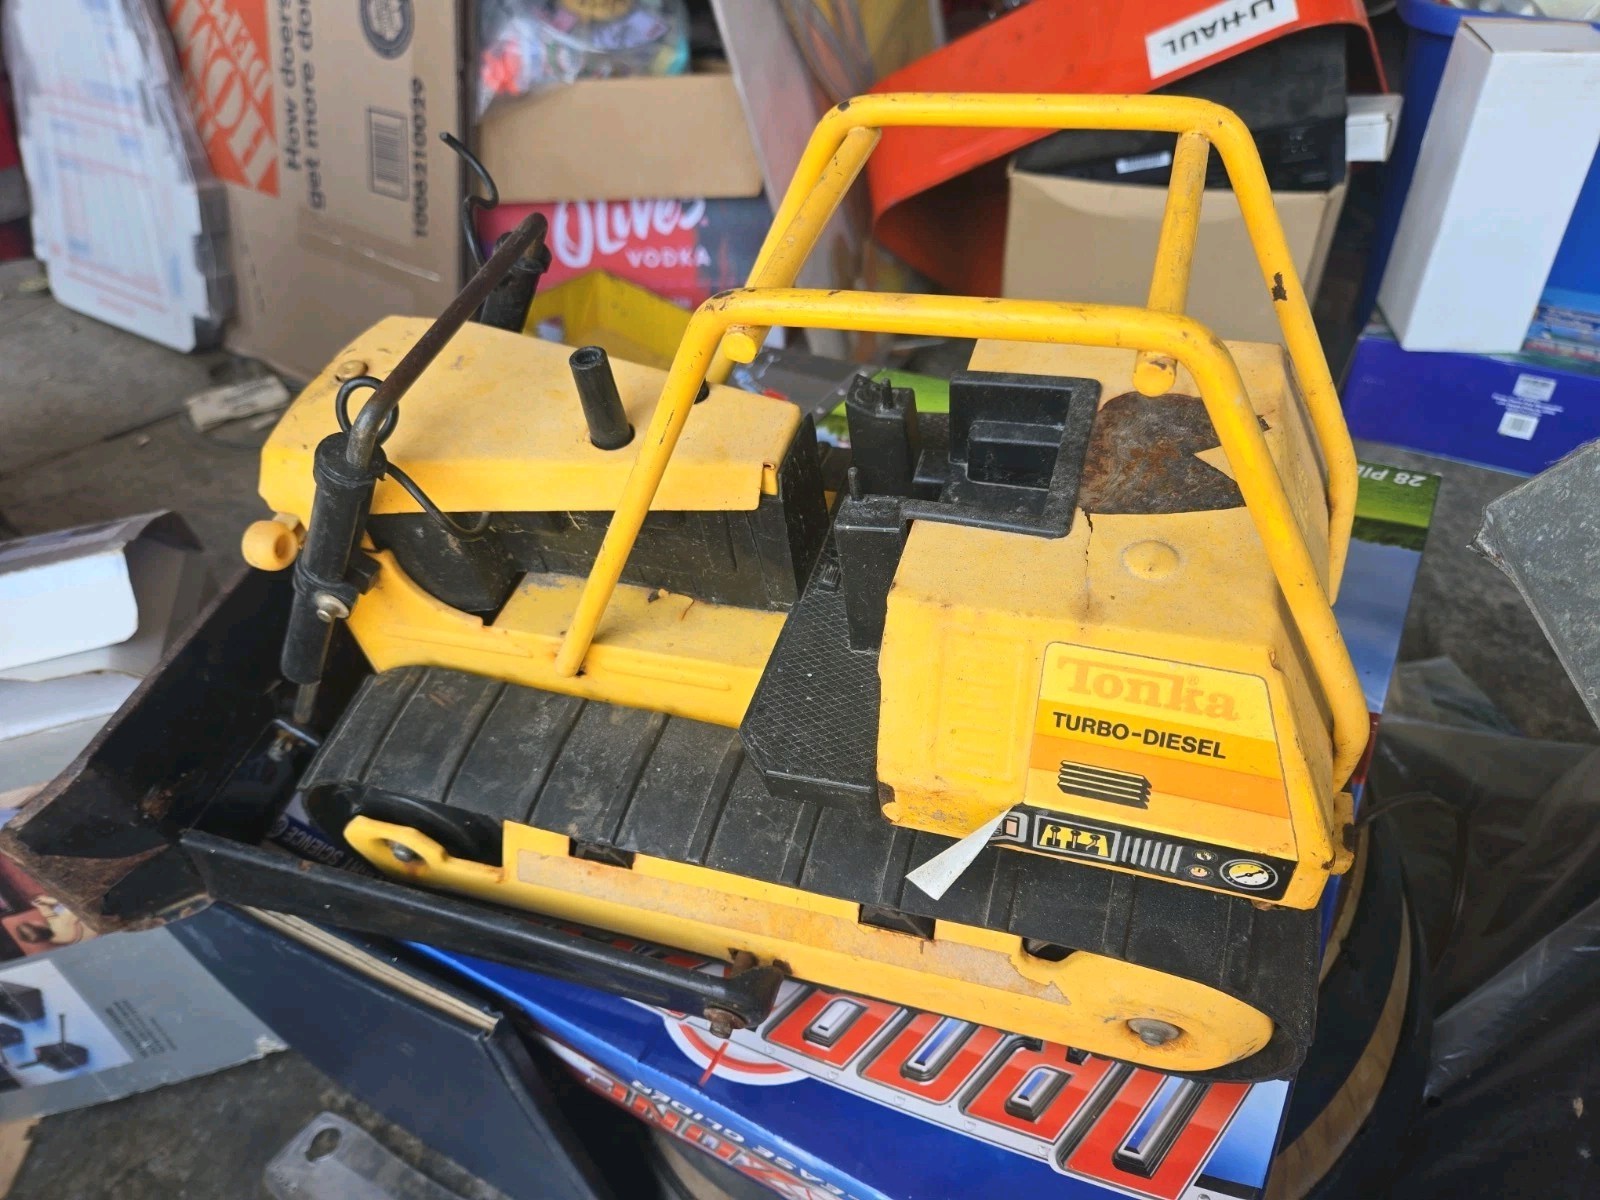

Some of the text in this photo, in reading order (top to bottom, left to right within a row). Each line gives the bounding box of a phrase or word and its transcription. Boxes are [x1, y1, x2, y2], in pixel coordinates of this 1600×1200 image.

[1160, 0, 1277, 58] U-HAUL
[302, 61, 318, 148] more
[284, 96, 301, 170] How
[304, 156, 326, 210] get
[626, 244, 711, 268] VODKA
[1393, 471, 1427, 487] 28
[1057, 656, 1240, 721] Tonka
[1053, 711, 1226, 759] TURBO-DIESEL
[284, 825, 345, 867] SCIENCE
[631, 1079, 746, 1144] GLIDER
